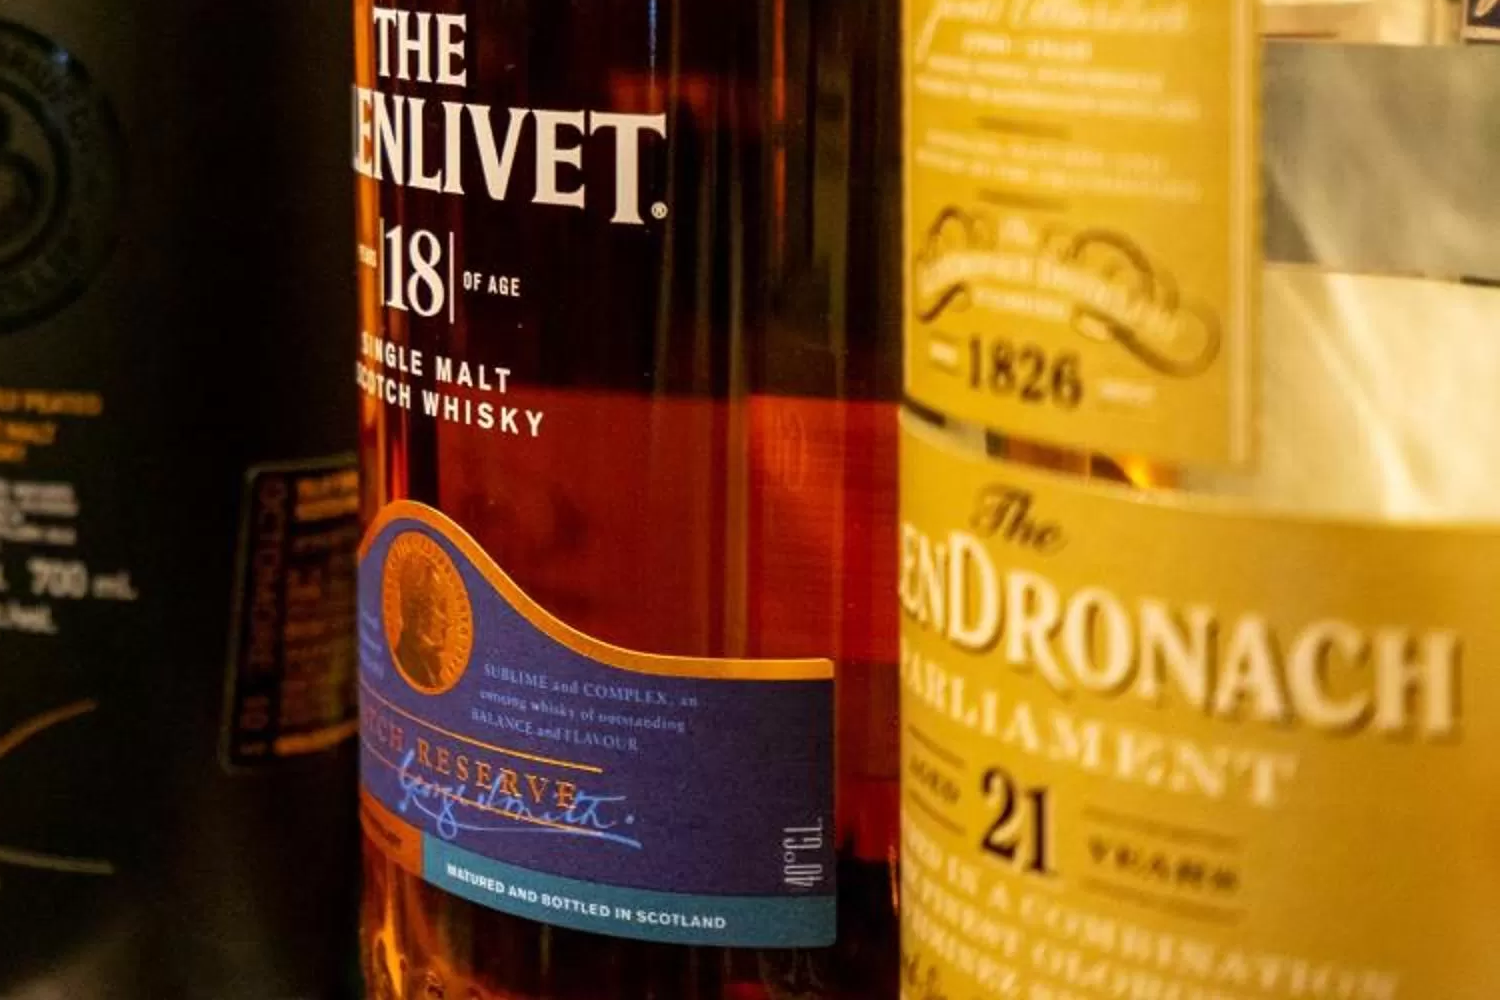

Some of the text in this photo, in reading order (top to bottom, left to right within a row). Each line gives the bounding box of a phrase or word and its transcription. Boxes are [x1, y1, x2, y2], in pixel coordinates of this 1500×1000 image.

[373, 6, 468, 88] THE
[353, 84, 667, 226] ENLIVET
[385, 225, 445, 318] 18
[463, 270, 483, 292] OF
[488, 275, 521, 298] AGE
[361, 331, 511, 394] SINGLE MALT
[968, 335, 1083, 410] 1826
[422, 389, 544, 438] WHISKY
[970, 484, 1066, 555] The
[898, 521, 1462, 736] ENDRONACH
[483, 662, 549, 690] SUBLIME
[552, 680, 579, 695] and
[580, 707, 595, 721] of
[471, 707, 533, 736] BALANCE
[900, 640, 1297, 808] ARLIAMENT
[414, 737, 577, 809] RESERVE
[978, 765, 1057, 877] 21
[446, 862, 728, 930] MATURED AND BOTTLED IN SCOTLAND
